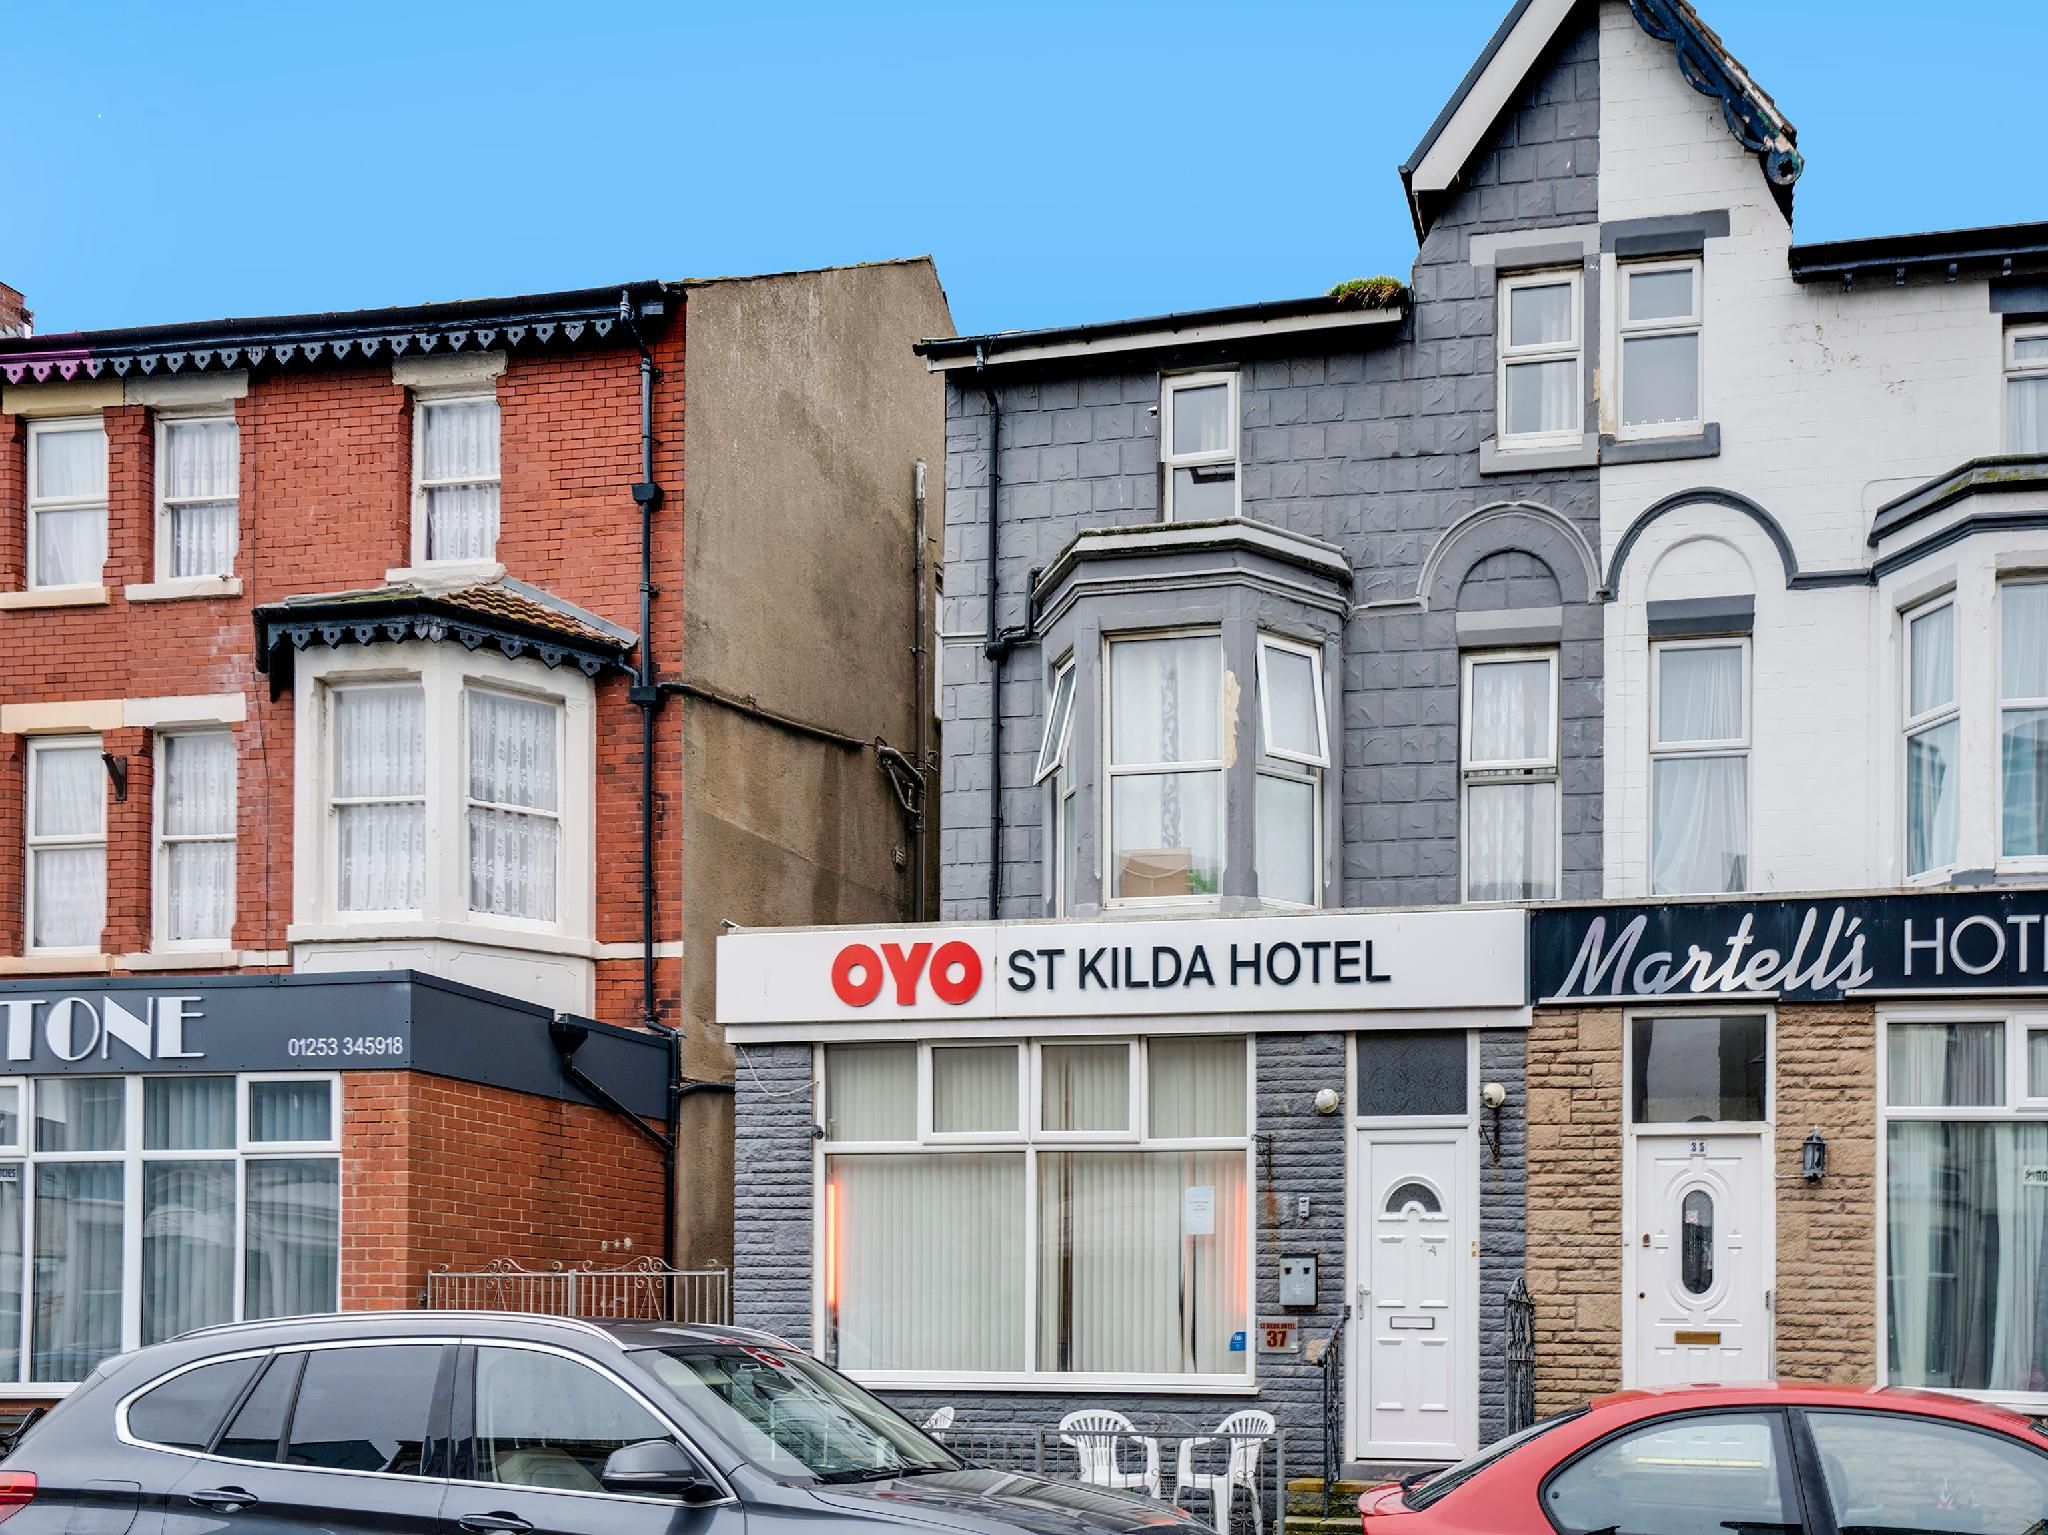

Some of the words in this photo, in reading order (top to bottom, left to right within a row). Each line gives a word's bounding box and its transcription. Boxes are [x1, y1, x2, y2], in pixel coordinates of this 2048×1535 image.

[831, 940, 983, 1007] OYO
[1007, 949, 1065, 992] ST
[1078, 945, 1215, 990] KILDA
[1229, 940, 1392, 986] HOTEL
[1553, 906, 1874, 998] Martell's
[287, 1037, 339, 1056] 01253
[342, 1036, 404, 1056] 345918
[1266, 1330, 1287, 1347] 37
